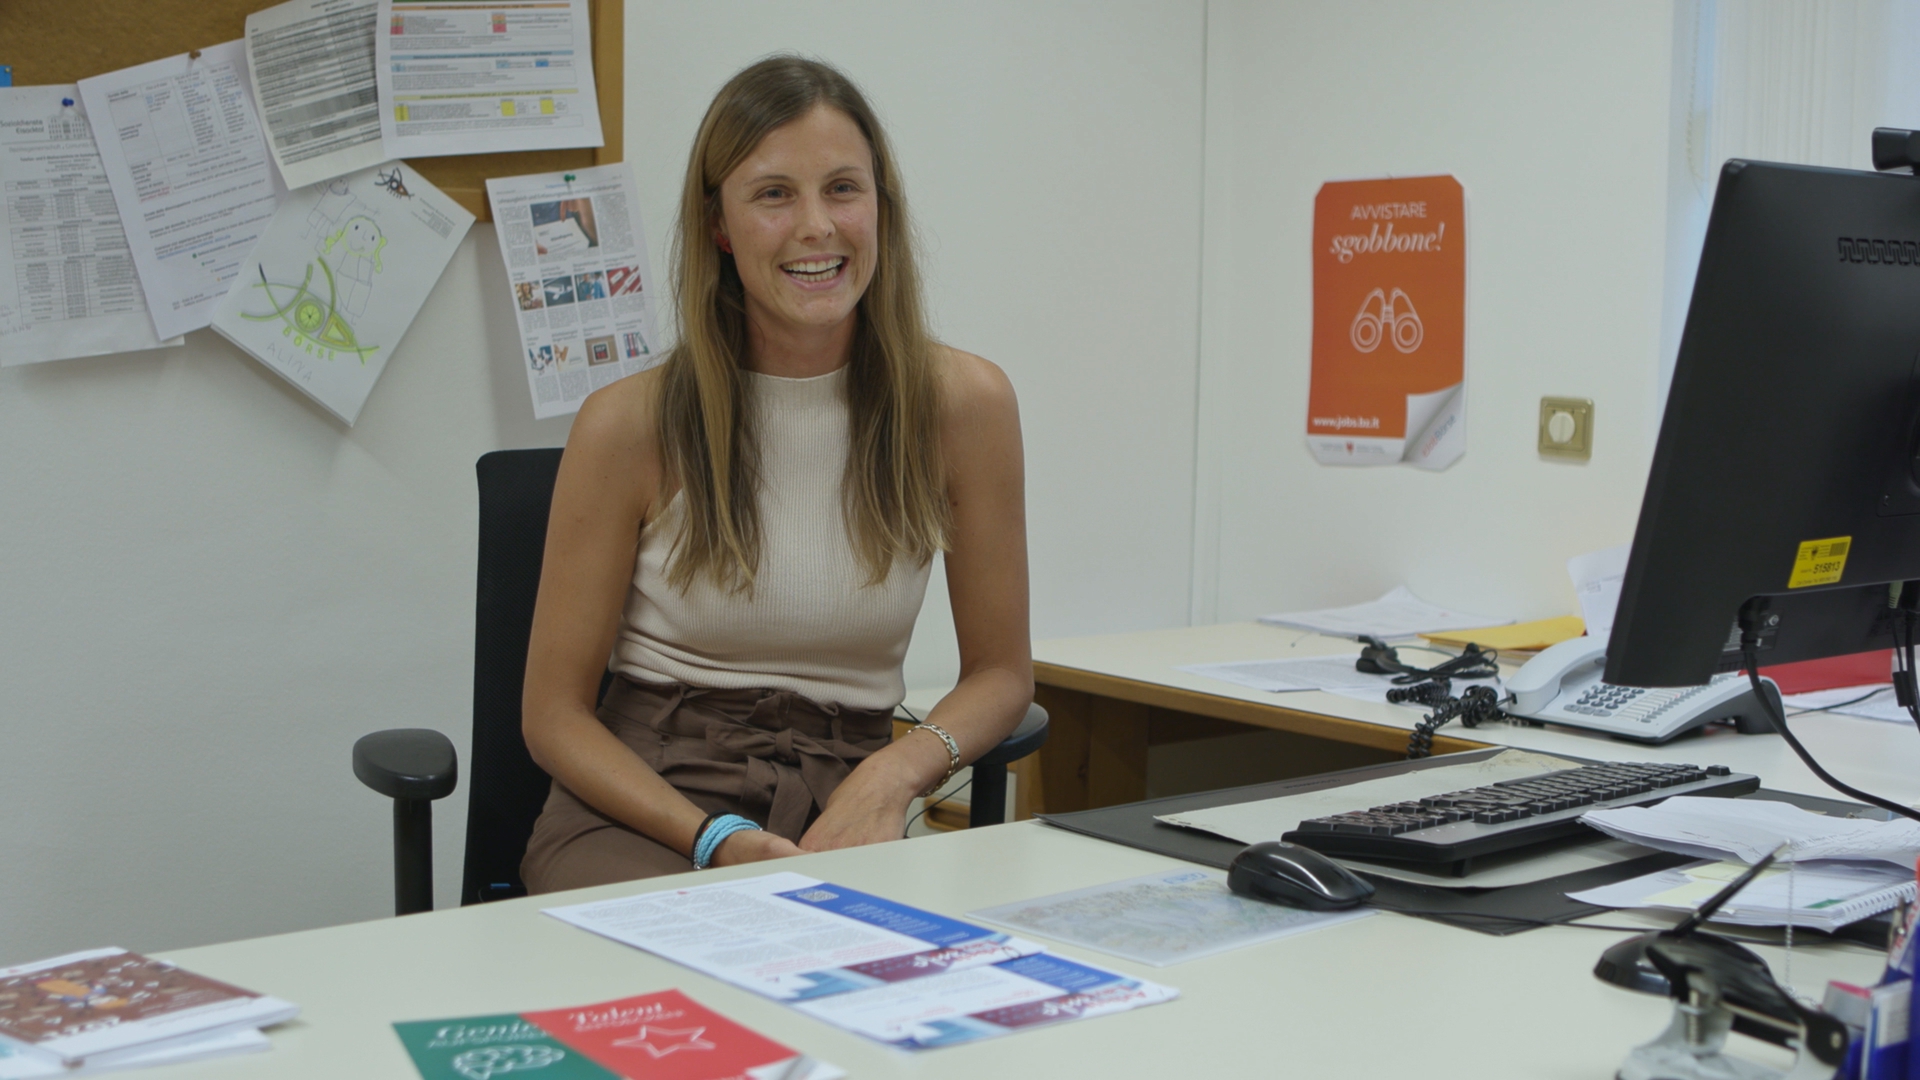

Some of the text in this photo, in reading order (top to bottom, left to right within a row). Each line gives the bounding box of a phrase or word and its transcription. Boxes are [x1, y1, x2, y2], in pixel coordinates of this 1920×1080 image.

[1351, 202, 1427, 220] AVVISTARE
[1330, 222, 1445, 263] sgobbone!
[1312, 415, 1380, 430] www.jobs.bz.it
[1813, 561, 1841, 574] 515813
[568, 1001, 666, 1025] Talent
